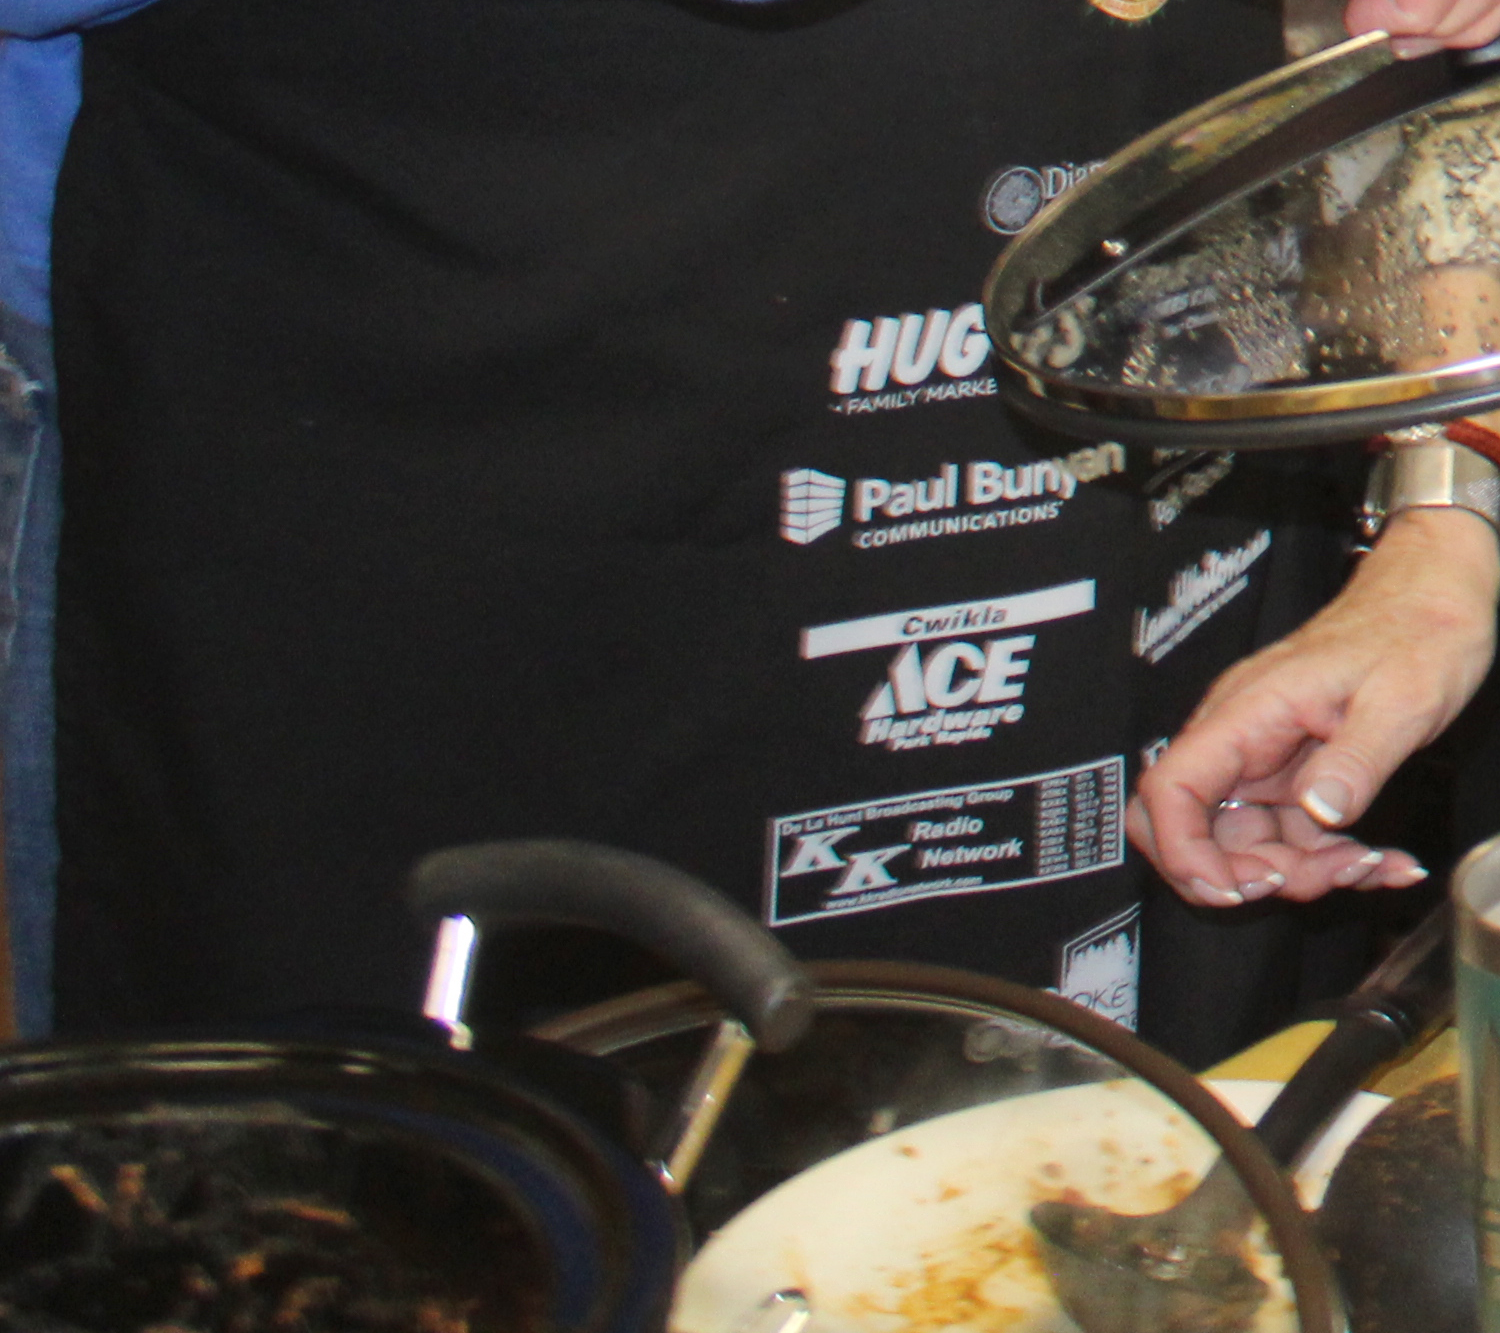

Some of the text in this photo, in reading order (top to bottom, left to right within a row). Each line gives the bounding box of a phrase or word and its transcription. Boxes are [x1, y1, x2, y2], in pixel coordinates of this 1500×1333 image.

[829, 302, 993, 395] HUG
[845, 376, 999, 416] FAMILY MARKE
[854, 462, 959, 523] Paul
[966, 440, 1126, 506] Bunyan
[854, 504, 1060, 550] COMMUNICATIONS
[902, 606, 1009, 637] Cwikla
[861, 634, 1036, 721] ACE
[861, 702, 1025, 745] Hardware
[865, 794, 965, 821] Broadcasting
[966, 787, 1014, 808] Group
[909, 816, 984, 843] Radio
[919, 837, 1024, 870] Network
